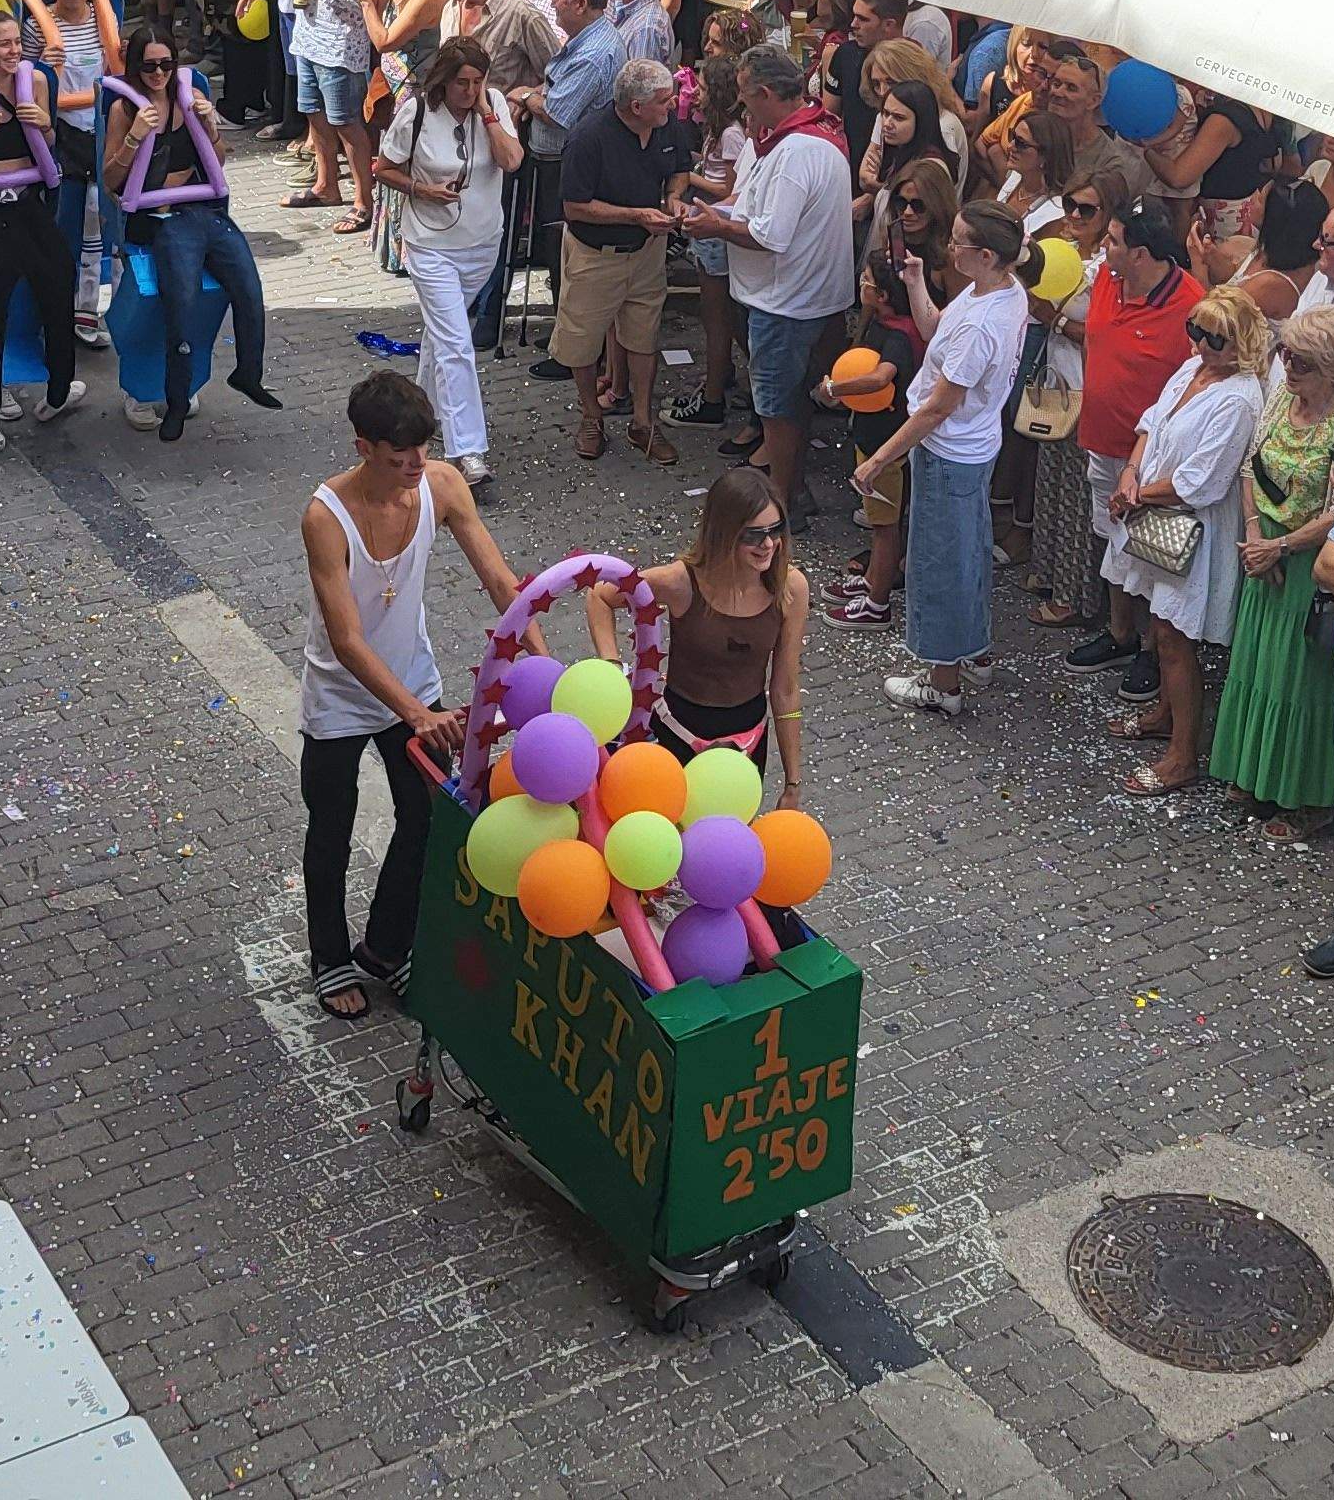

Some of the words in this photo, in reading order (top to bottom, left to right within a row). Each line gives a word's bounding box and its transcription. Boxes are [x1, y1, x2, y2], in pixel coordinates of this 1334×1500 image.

[1195, 55, 1279, 95] CERVECEROS
[511, 979, 658, 1187] KHAN
[754, 1007, 789, 1081] 1
[703, 1057, 849, 1142] VIAJE
[723, 1118, 829, 1204] 2'50
